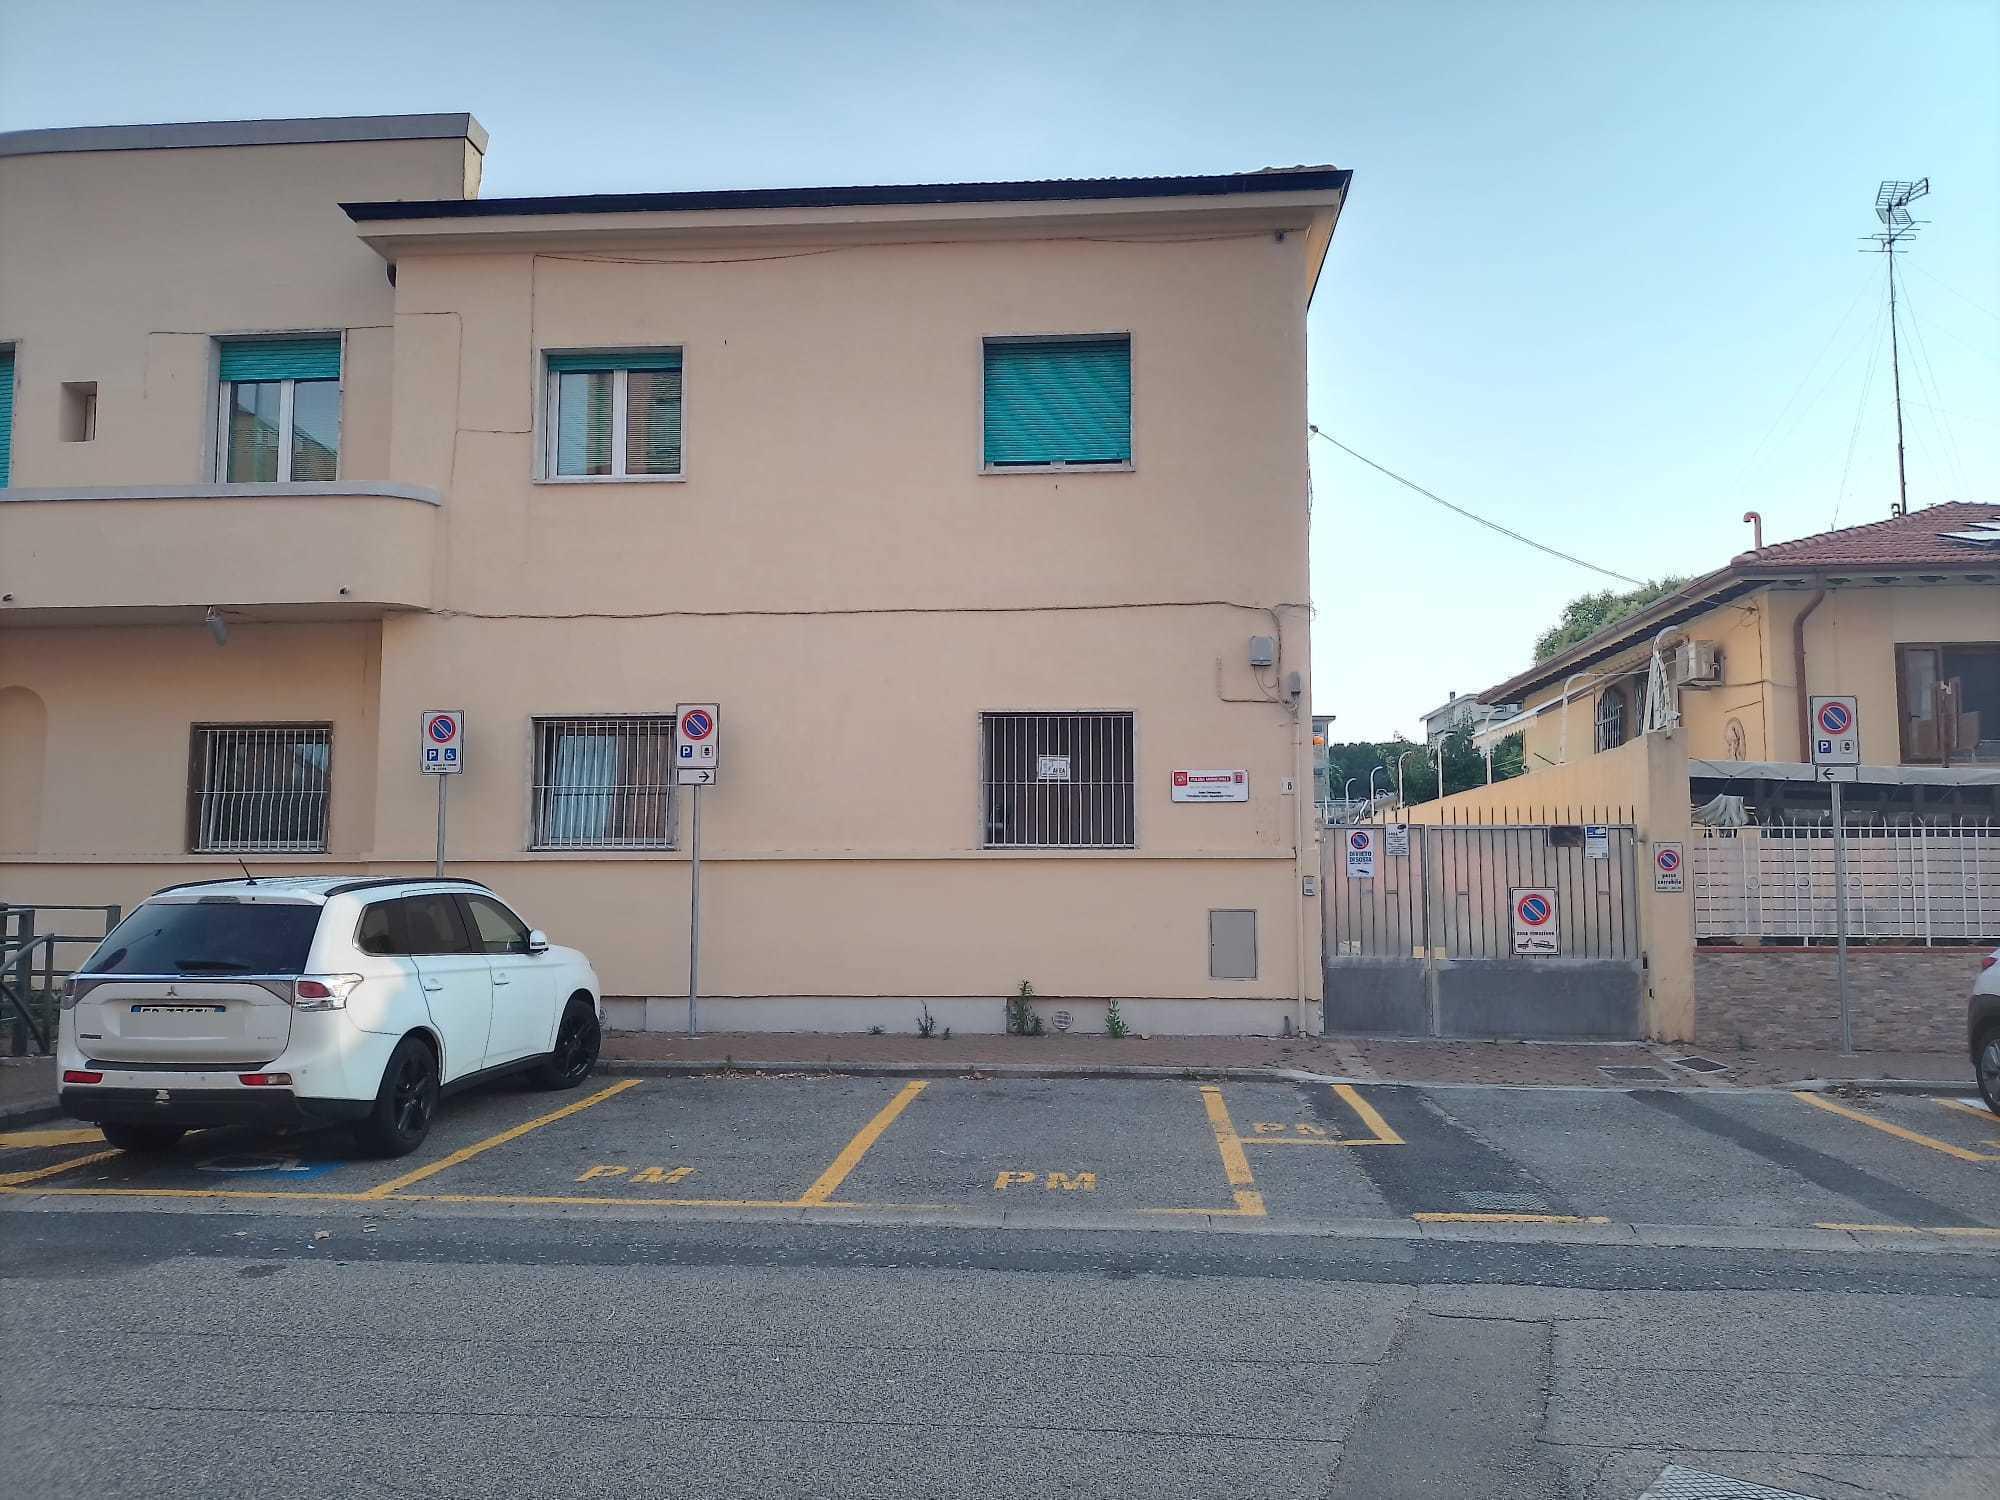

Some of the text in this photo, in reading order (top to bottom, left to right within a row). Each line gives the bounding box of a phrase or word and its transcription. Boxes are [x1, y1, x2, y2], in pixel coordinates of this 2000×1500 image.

[682, 746, 690, 756] P
[1820, 742, 1828, 752] P
[429, 750, 437, 760] P
[992, 1171, 1097, 1191] PM
